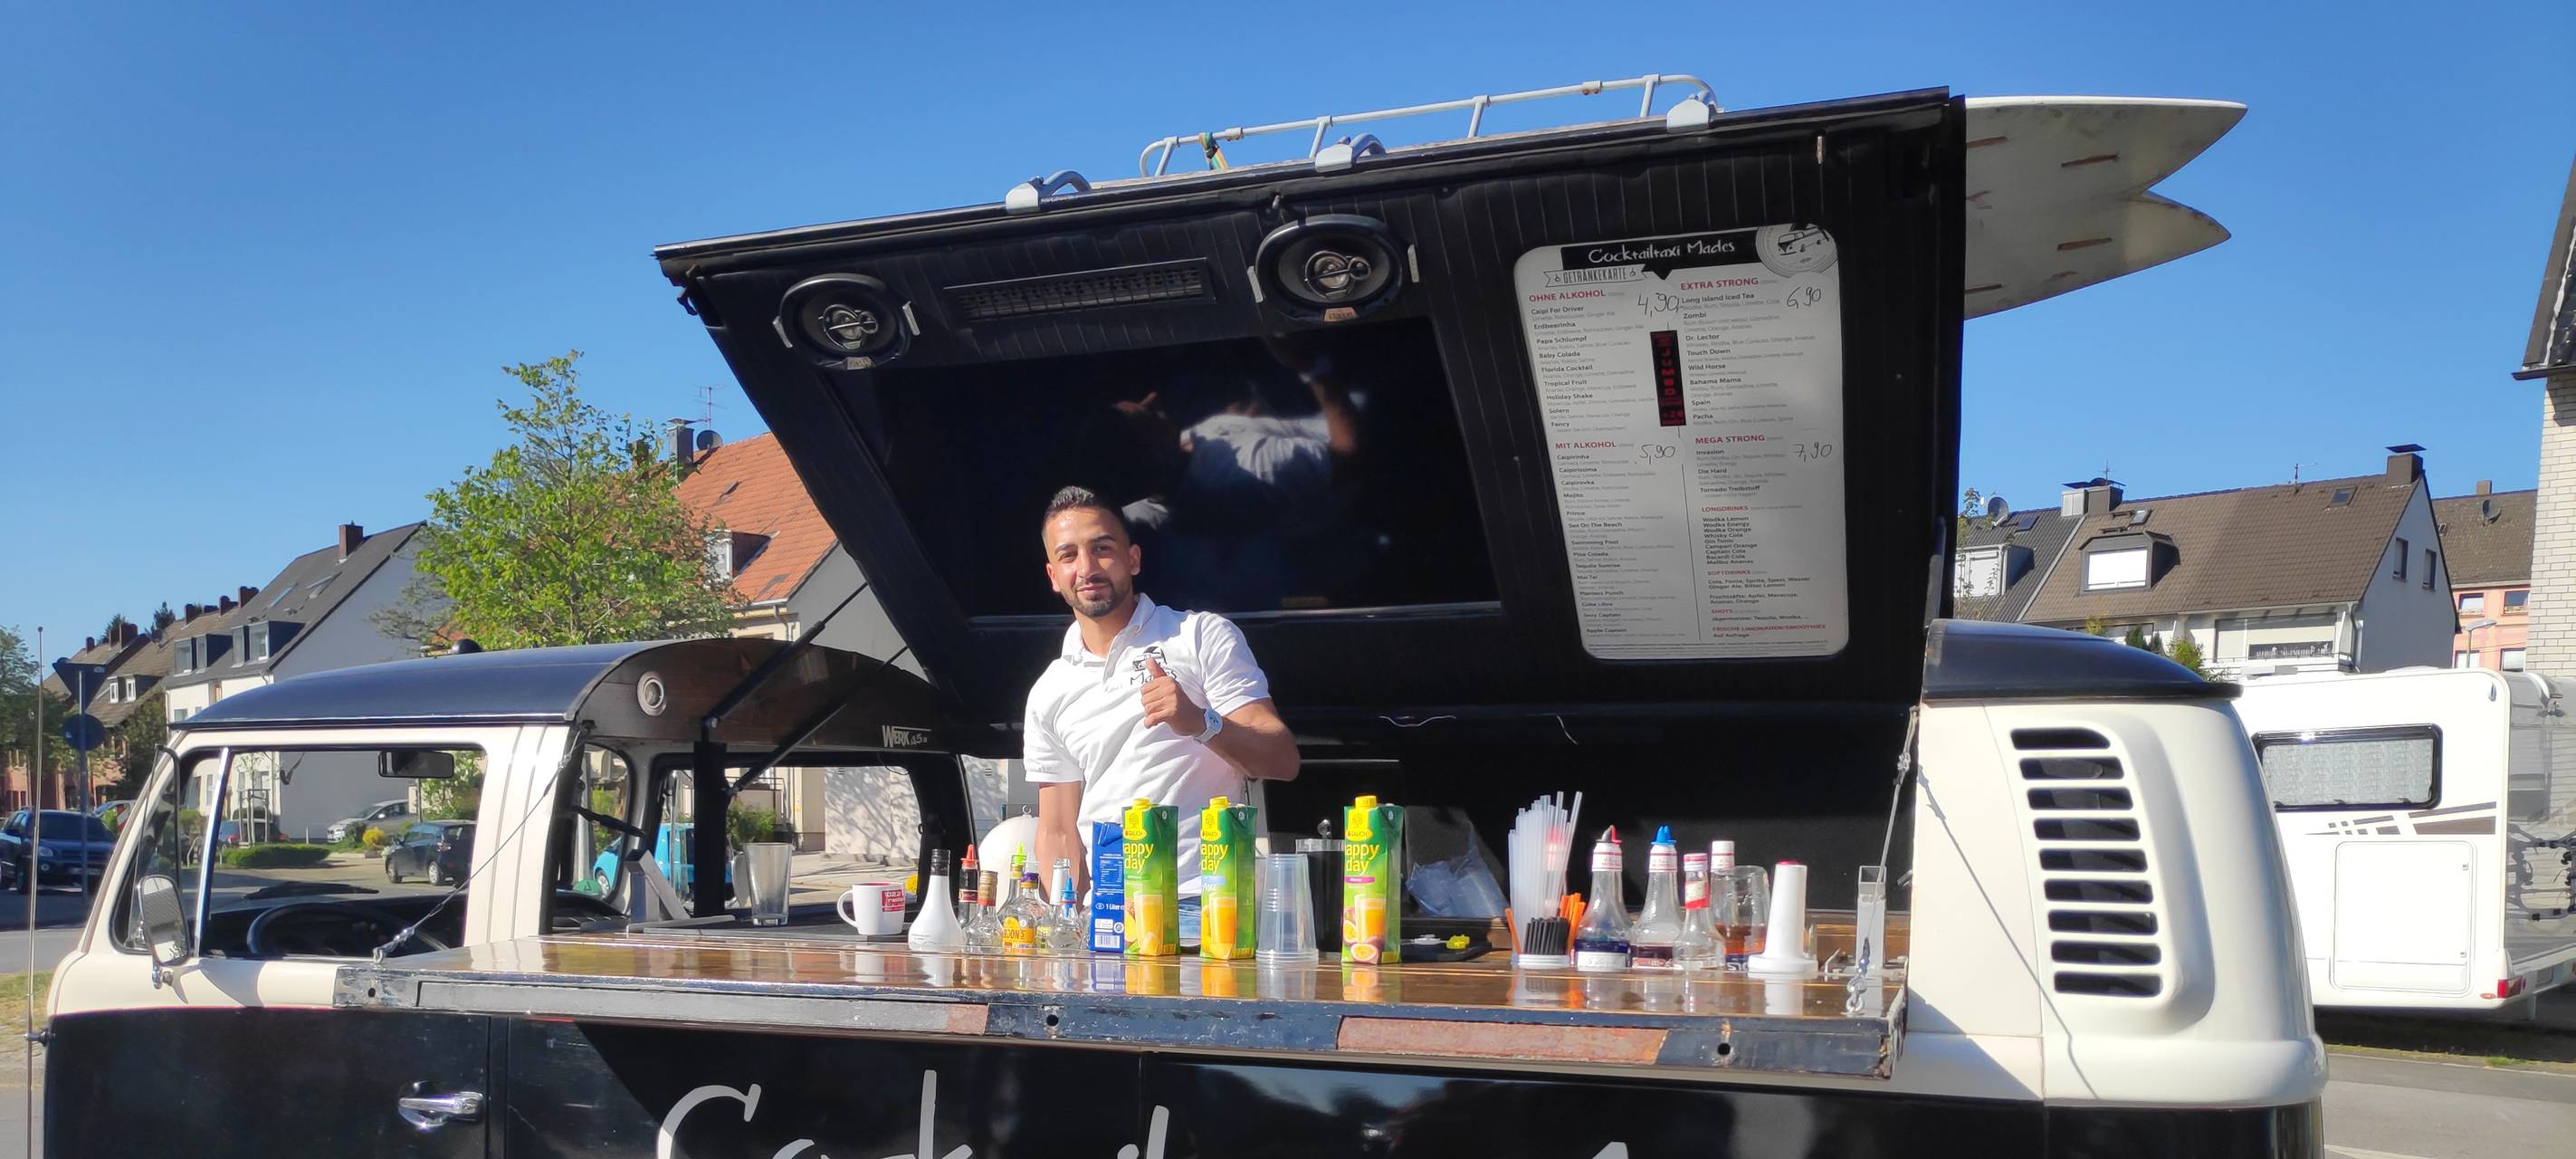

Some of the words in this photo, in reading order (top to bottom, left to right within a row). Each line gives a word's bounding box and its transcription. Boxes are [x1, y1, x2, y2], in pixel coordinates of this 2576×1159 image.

[1589, 244, 1681, 263] Cocktailtaxi
[1687, 239, 1735, 254] Mades
[1681, 281, 1713, 290] EXTRA
[1715, 277, 1759, 288] STRONG
[1530, 292, 1557, 302] OHNE
[1560, 289, 1606, 301] ALKOHOL
[1725, 435, 1765, 443] STRONG
[1125, 855, 1145, 874] day
[1202, 856, 1220, 875] day
[1347, 857, 1369, 876] day
